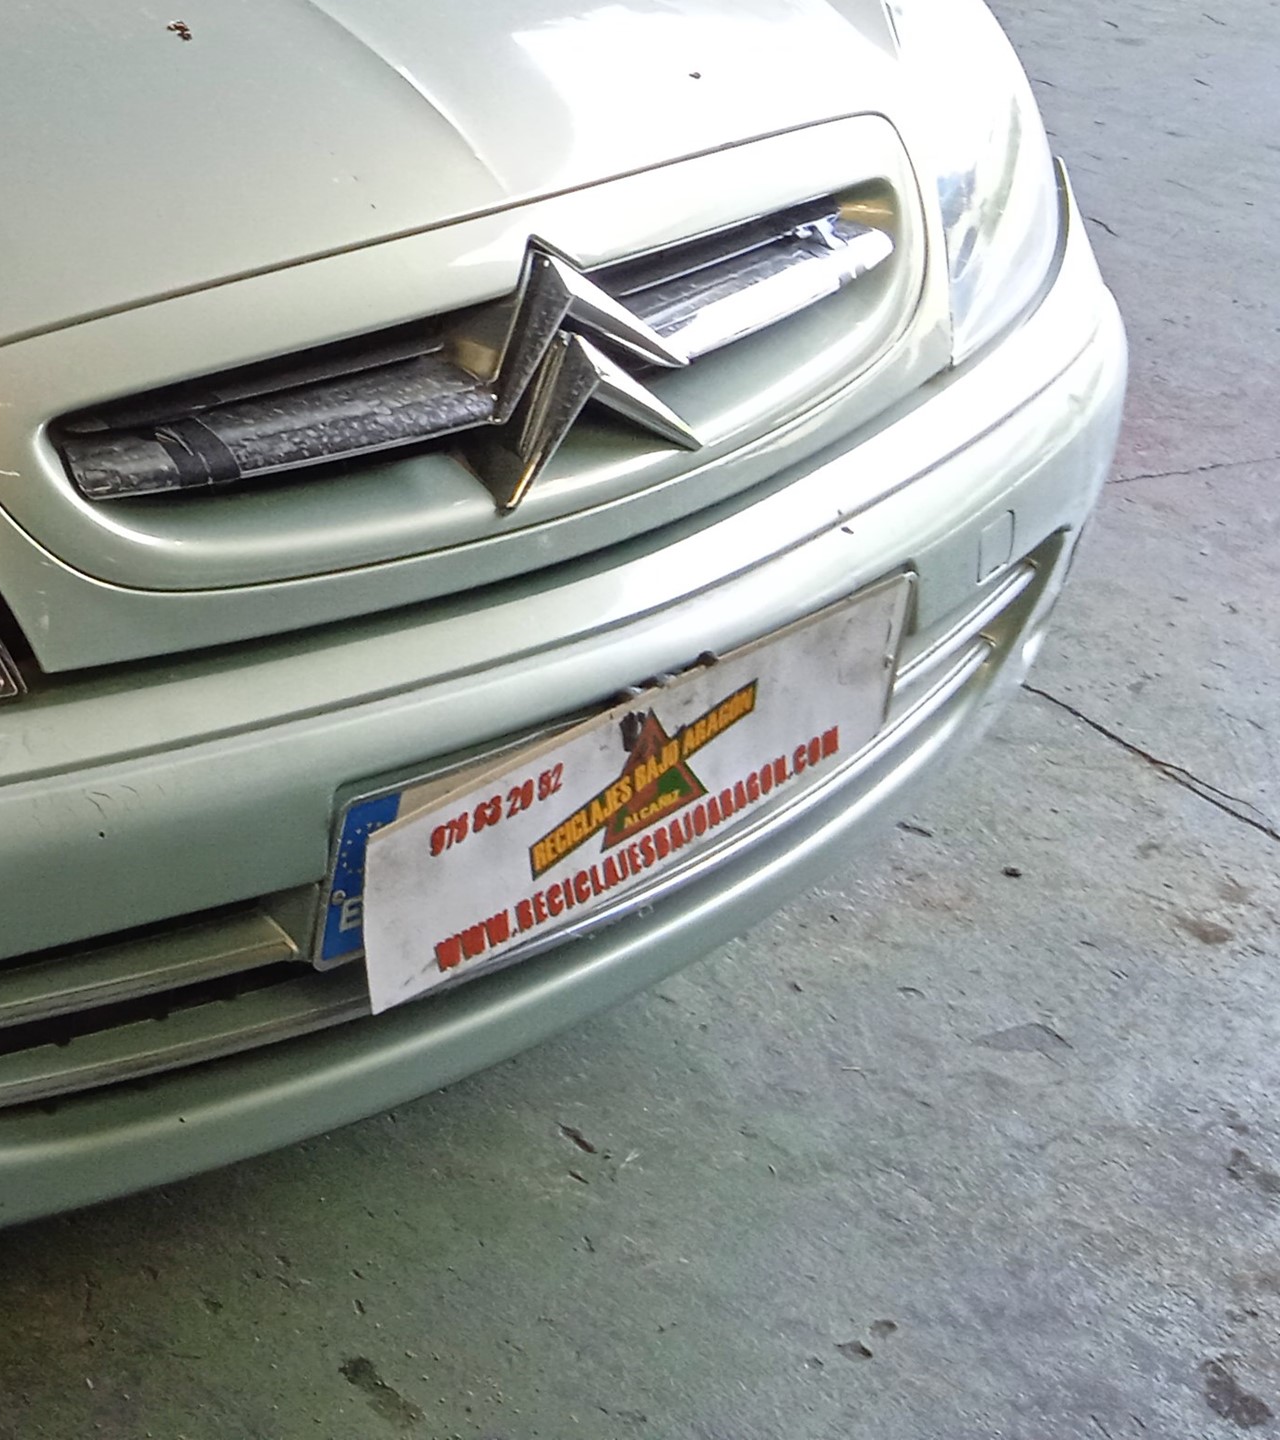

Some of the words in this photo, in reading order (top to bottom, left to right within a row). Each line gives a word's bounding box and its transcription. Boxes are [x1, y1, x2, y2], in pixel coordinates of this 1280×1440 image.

[433, 725, 839, 973] WWW.RECICLAJESBAJOARAGON.COM
[532, 776, 633, 871] RECICLAJES
[634, 739, 680, 792] BAJO
[339, 896, 364, 933] E
